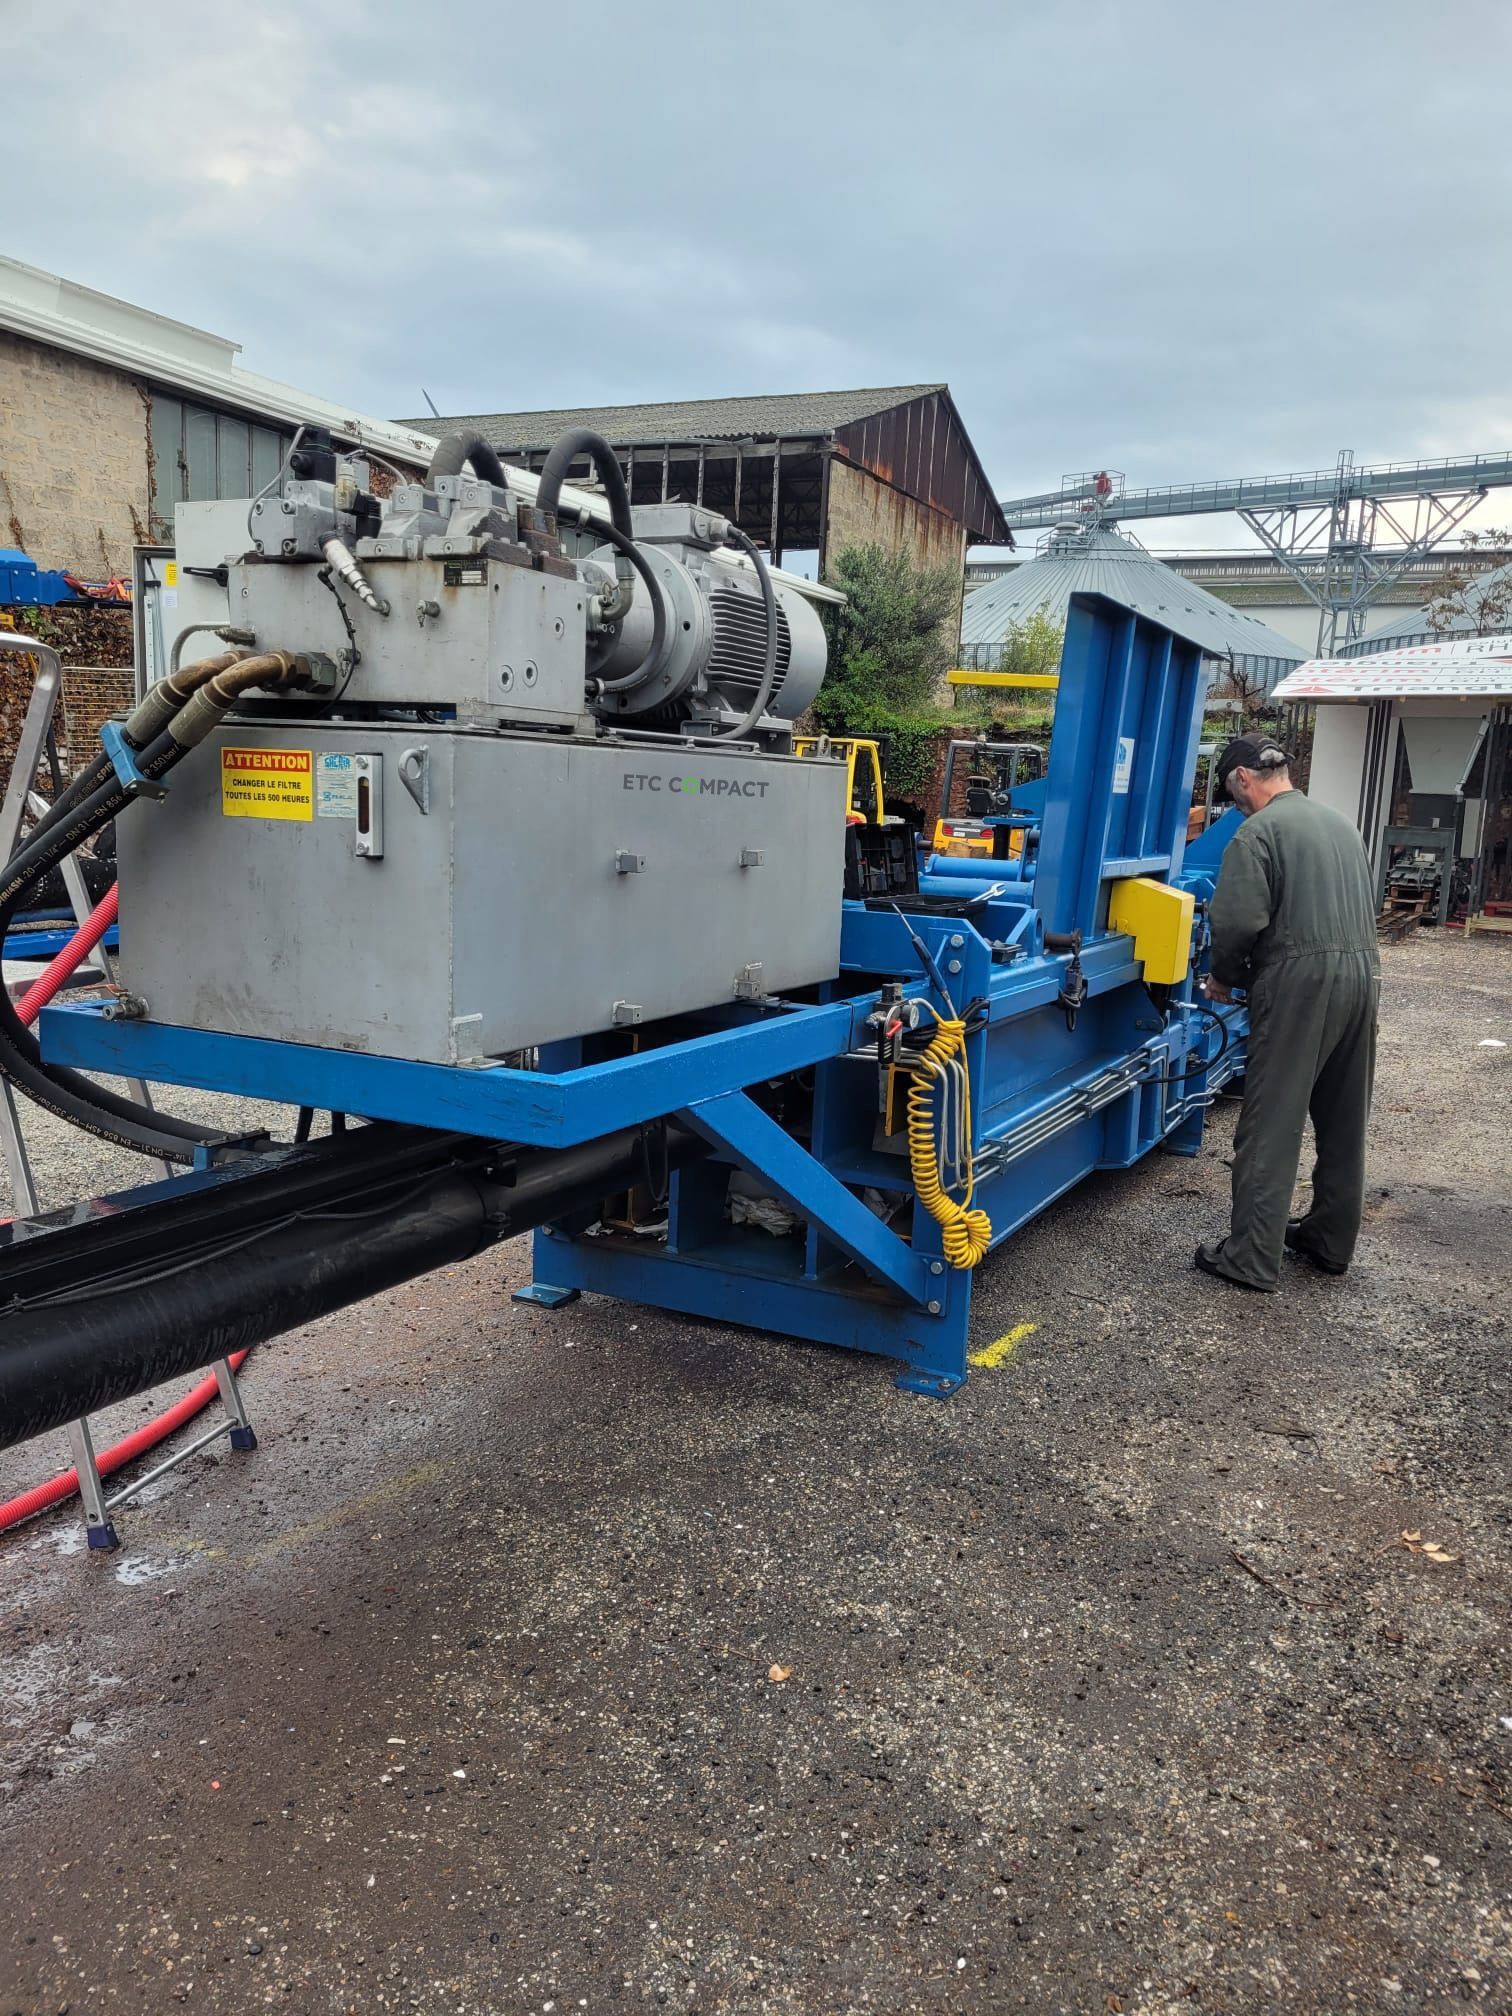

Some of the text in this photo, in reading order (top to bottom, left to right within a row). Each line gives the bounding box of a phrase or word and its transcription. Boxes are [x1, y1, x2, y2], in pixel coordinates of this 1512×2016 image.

[225, 753, 307, 769] ATTENTION
[232, 778, 265, 788] CHANGER
[277, 781, 301, 790] FILTRE
[623, 773, 770, 798] ETC COMPACT
[225, 791, 310, 804] TOUTES LES 500 HEURES
[94, 804, 109, 817] EN
[105, 793, 123, 808] 856
[50, 1104, 67, 1117] 350
[103, 1130, 119, 1142] 856
[120, 1137, 132, 1146] EN
